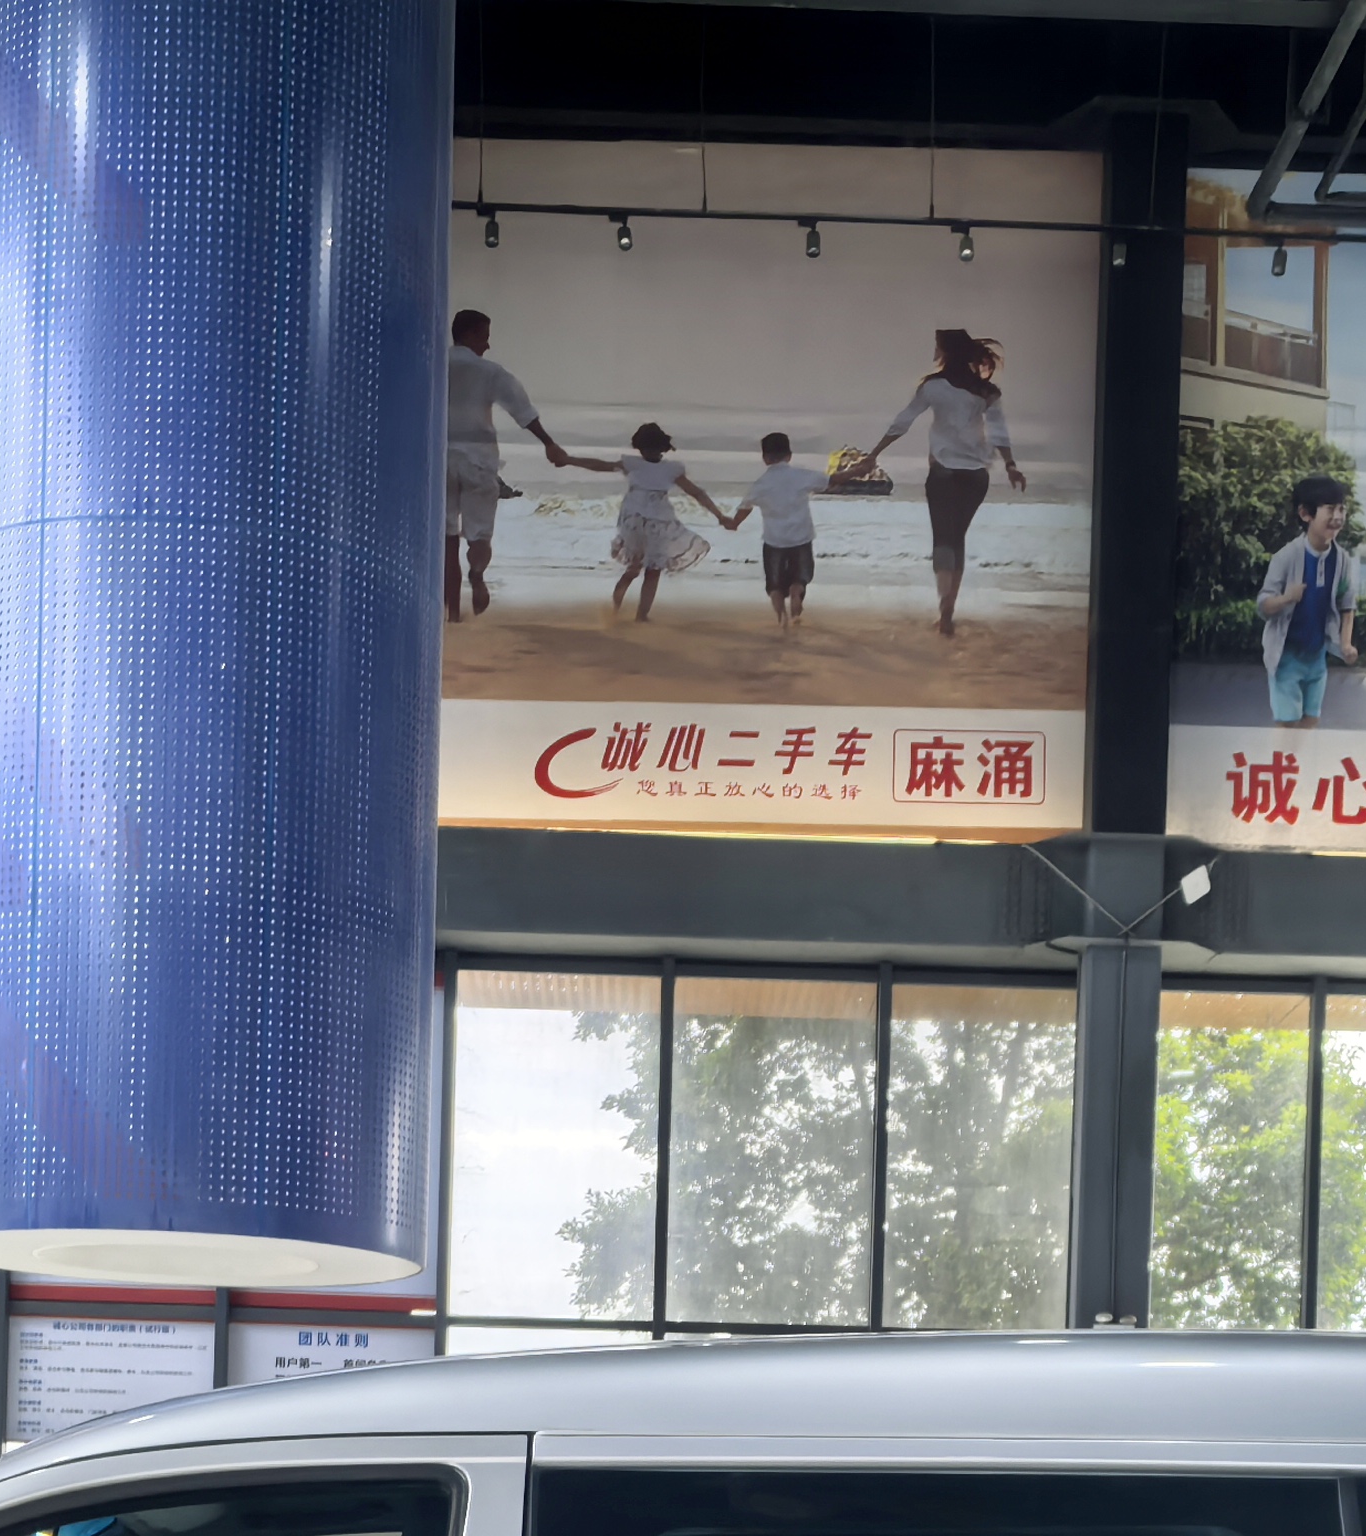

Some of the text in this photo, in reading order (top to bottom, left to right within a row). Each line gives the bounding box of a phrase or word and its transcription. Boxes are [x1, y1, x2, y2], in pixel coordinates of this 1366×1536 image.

[600, 720, 1034, 799] 诚心二手车 麻涌
[636, 779, 862, 801] 您真正放心的选择
[298, 1331, 369, 1348] 团队准则
[275, 1356, 322, 1369] 用户第一
